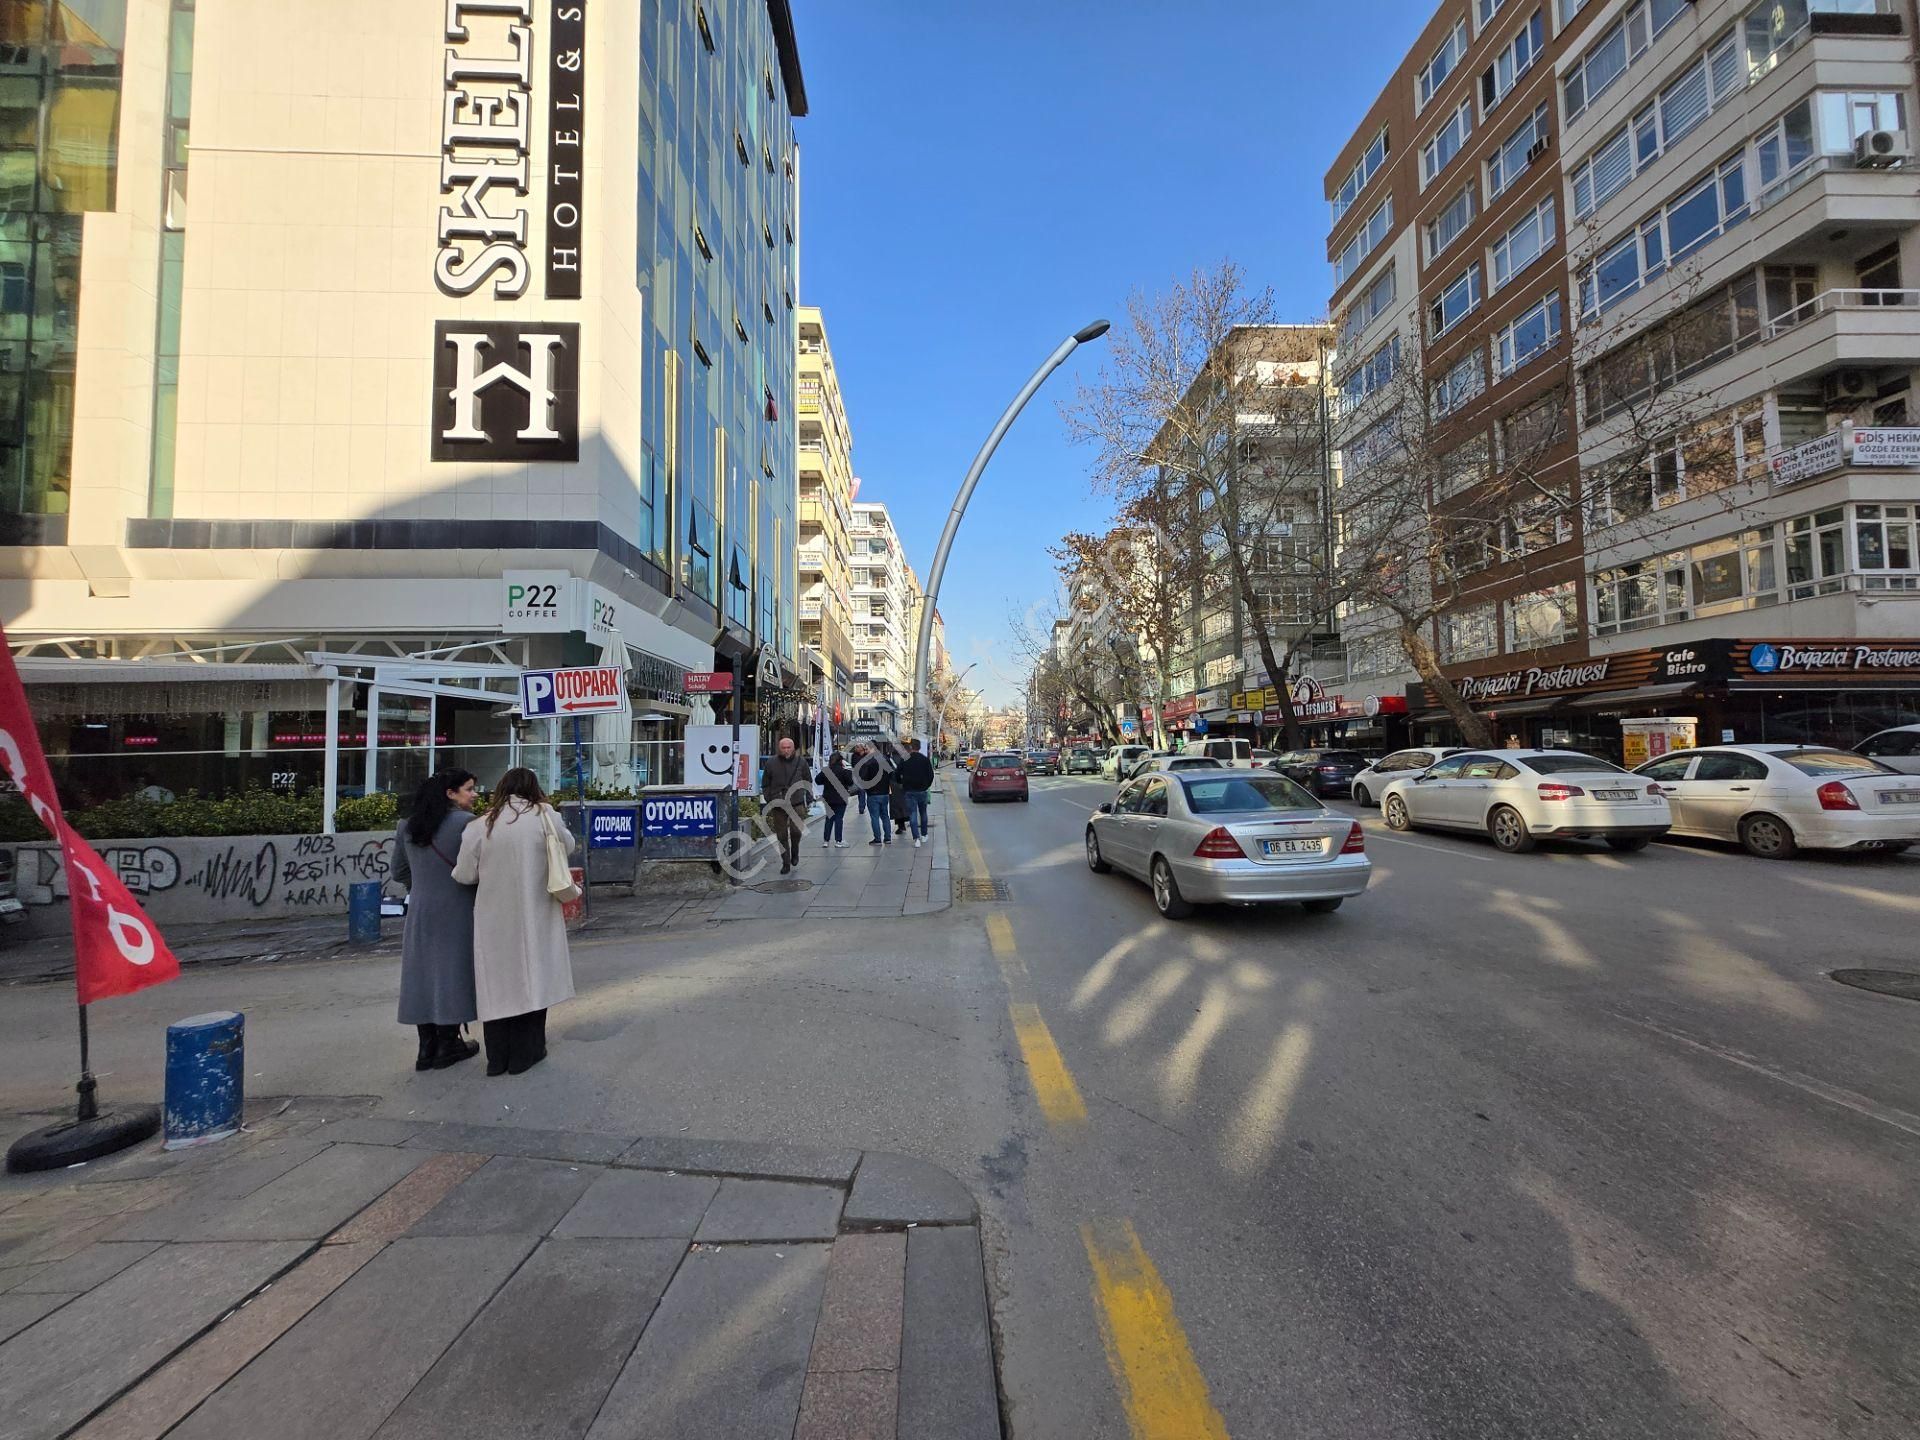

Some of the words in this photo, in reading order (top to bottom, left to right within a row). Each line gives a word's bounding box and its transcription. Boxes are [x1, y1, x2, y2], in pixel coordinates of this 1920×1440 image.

[553, 93, 580, 272] HOTEL
[508, 585, 557, 608] P22
[508, 610, 558, 618] COFFEE
[593, 599, 615, 627] P22
[1666, 649, 1695, 663] Cafe
[1780, 646, 1850, 671] Boğaziçi
[1461, 672, 1522, 700] Boğaziçi
[1525, 657, 1610, 696] Pastanesi
[1667, 662, 1706, 676] Bistro
[687, 675, 711, 683] HATAY
[525, 674, 551, 714] P
[555, 668, 619, 700] OTOPARK
[657, 689, 682, 705] COFFEE
[272, 772, 296, 784] P22
[646, 800, 714, 822] OTOPARK
[594, 815, 632, 832] OTOPARK
[294, 835, 336, 857] 1903
[1269, 840, 1281, 852] 06
[1285, 840, 1297, 852] EA
[1301, 839, 1321, 851] 2435
